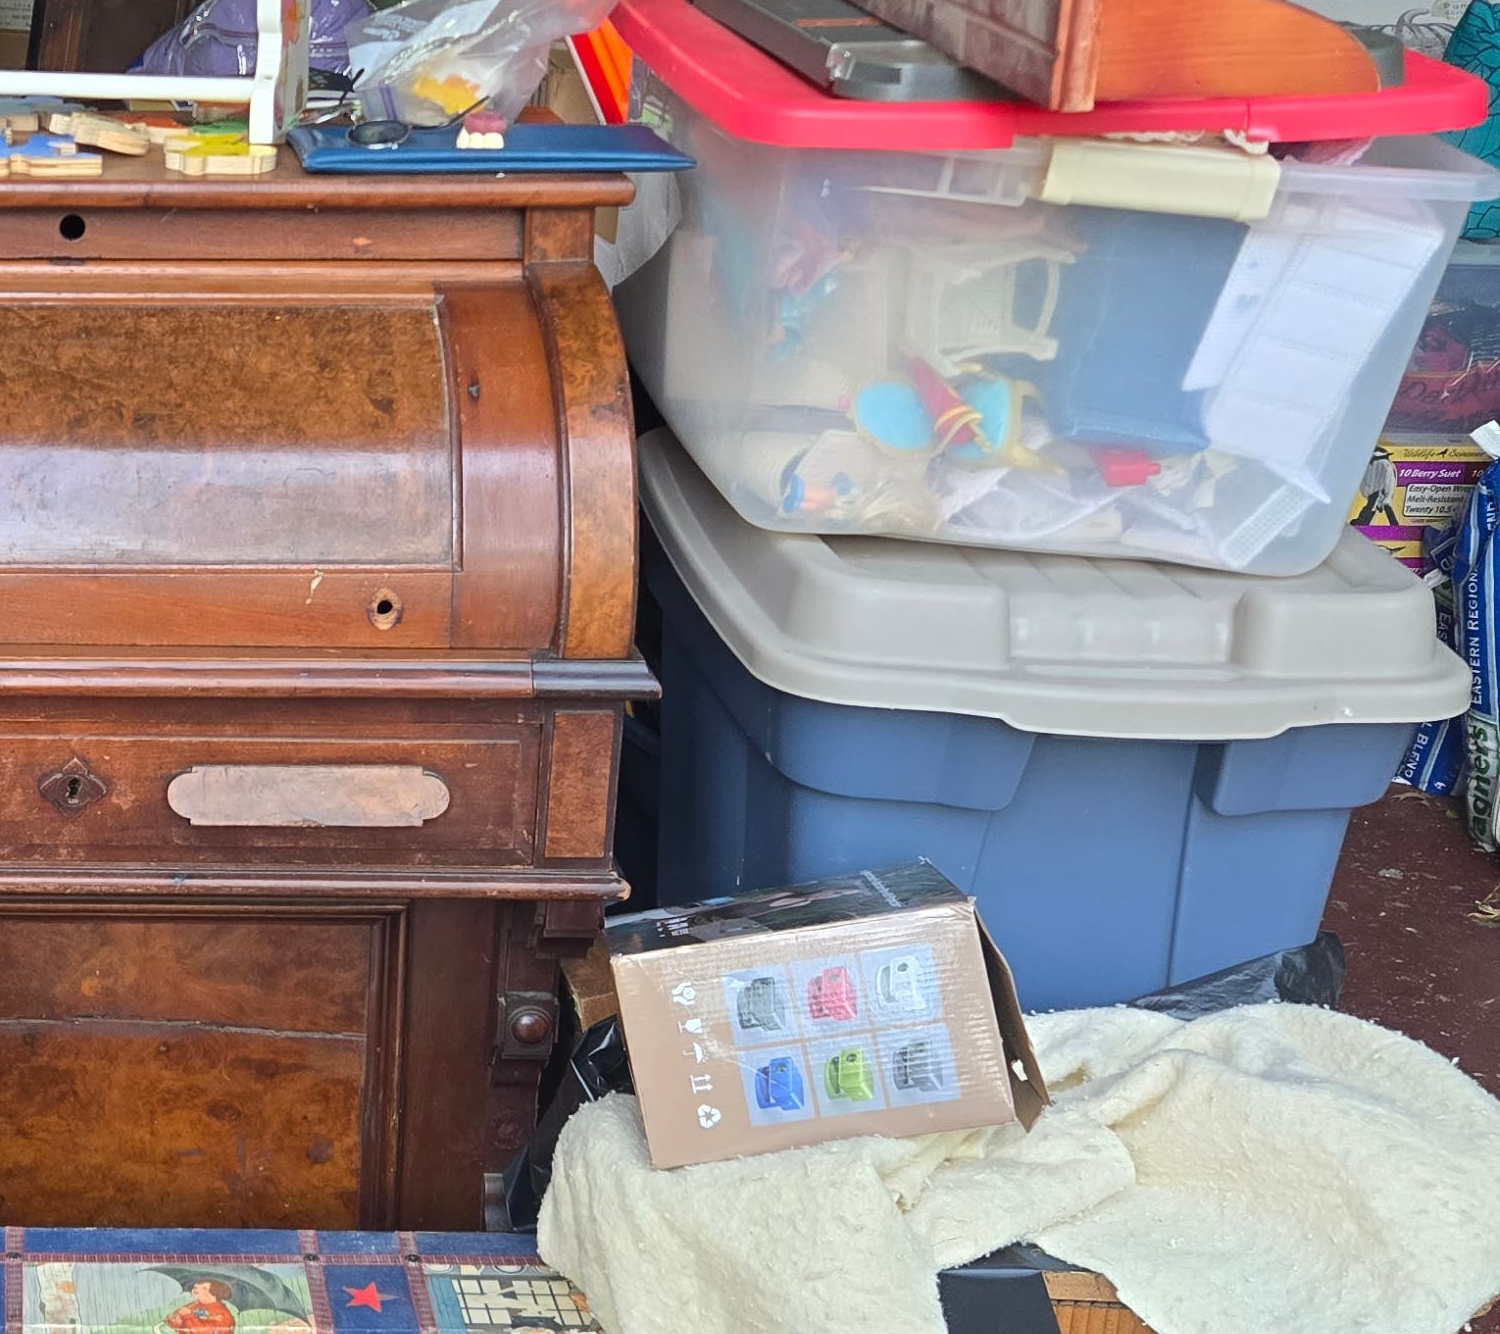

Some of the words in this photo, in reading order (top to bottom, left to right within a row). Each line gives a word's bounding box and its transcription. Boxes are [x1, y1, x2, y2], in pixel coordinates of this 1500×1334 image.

[1399, 469, 1412, 478] 10
[1411, 469, 1439, 479] Berry
[1438, 469, 1462, 478] Suet
[1471, 637, 1482, 705] EASTERN
[1404, 733, 1429, 778] BLEND
